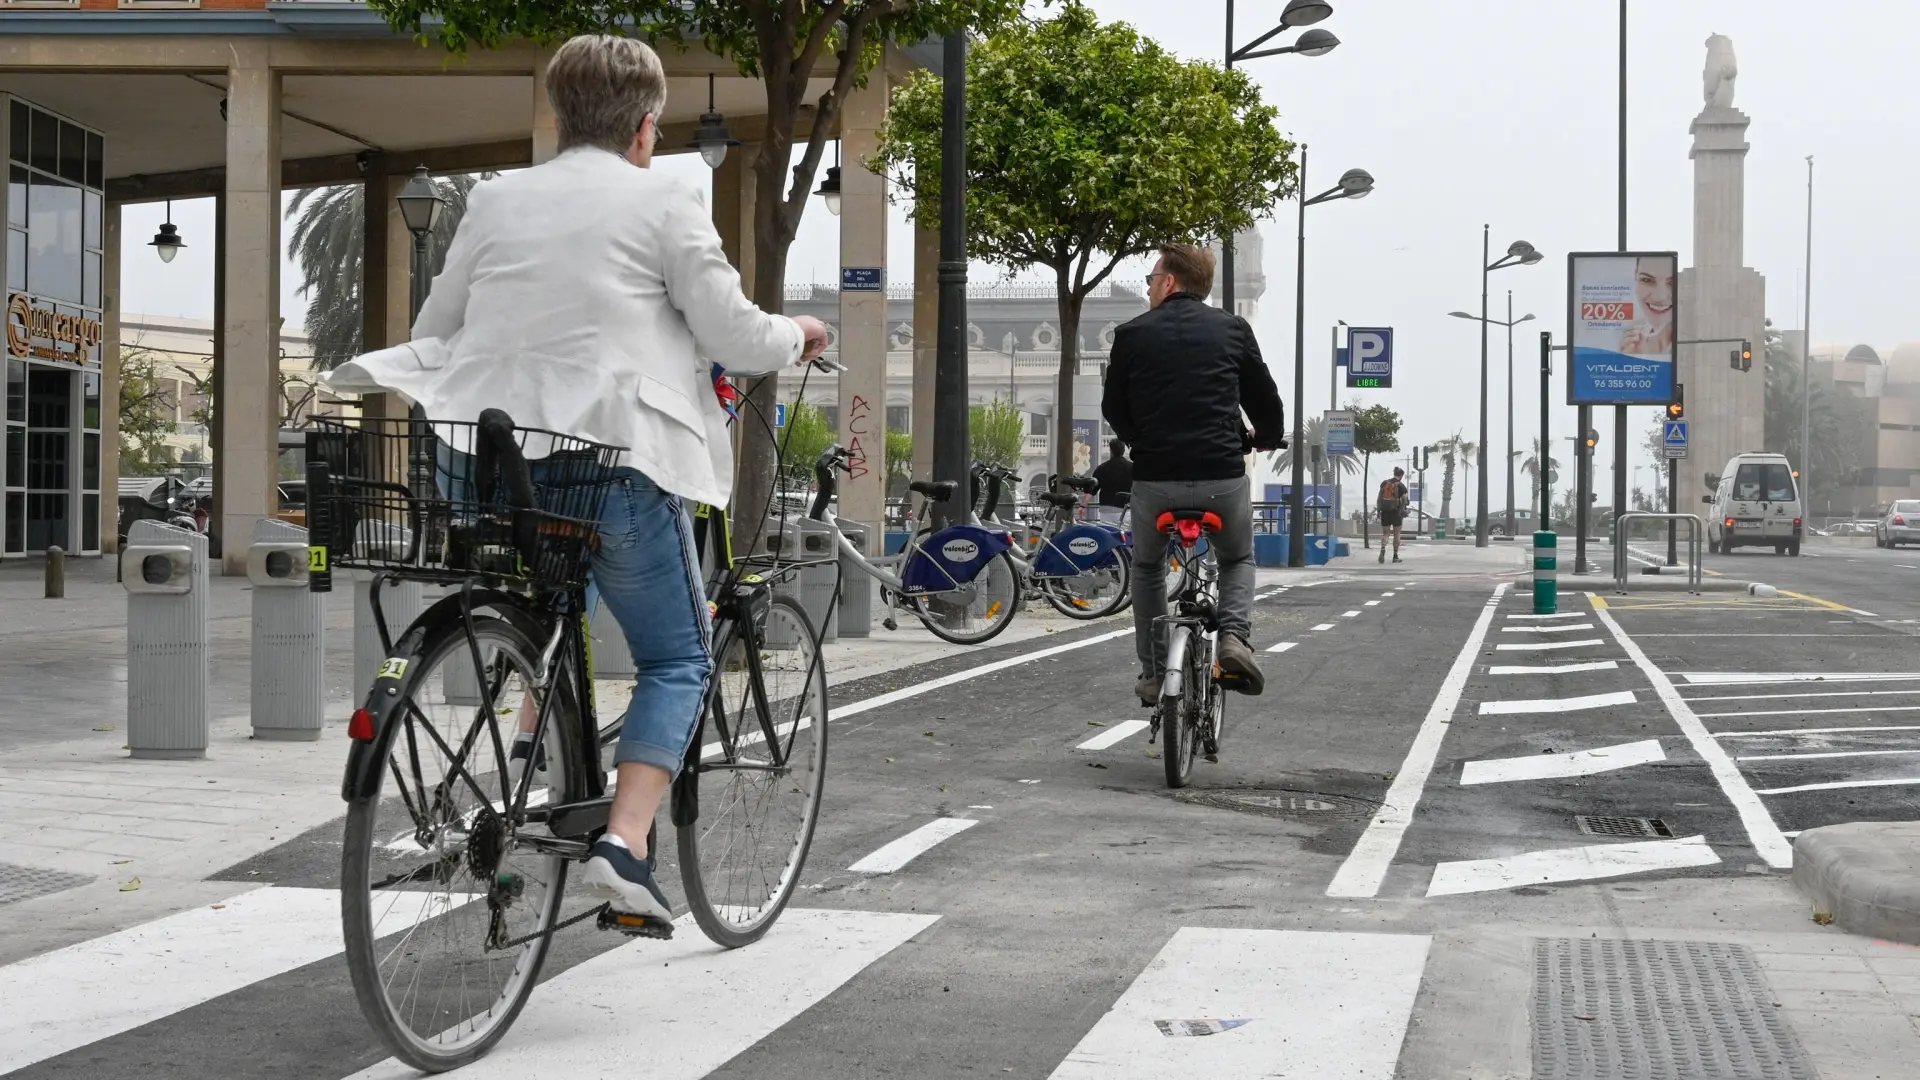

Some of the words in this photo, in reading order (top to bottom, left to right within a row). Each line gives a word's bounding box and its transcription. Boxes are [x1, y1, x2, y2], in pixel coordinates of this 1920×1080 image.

[1583, 303, 1625, 320] 20%
[1352, 333, 1384, 372] P
[1586, 364, 1660, 372] VITALDENT
[1357, 378, 1379, 387] LIBRE
[1594, 379, 1606, 388] 96
[1607, 379, 1624, 388] 355
[1625, 379, 1637, 388] 96
[1638, 379, 1652, 388] 00
[1072, 426, 1090, 436] alles
[380, 660, 402, 675] 91
